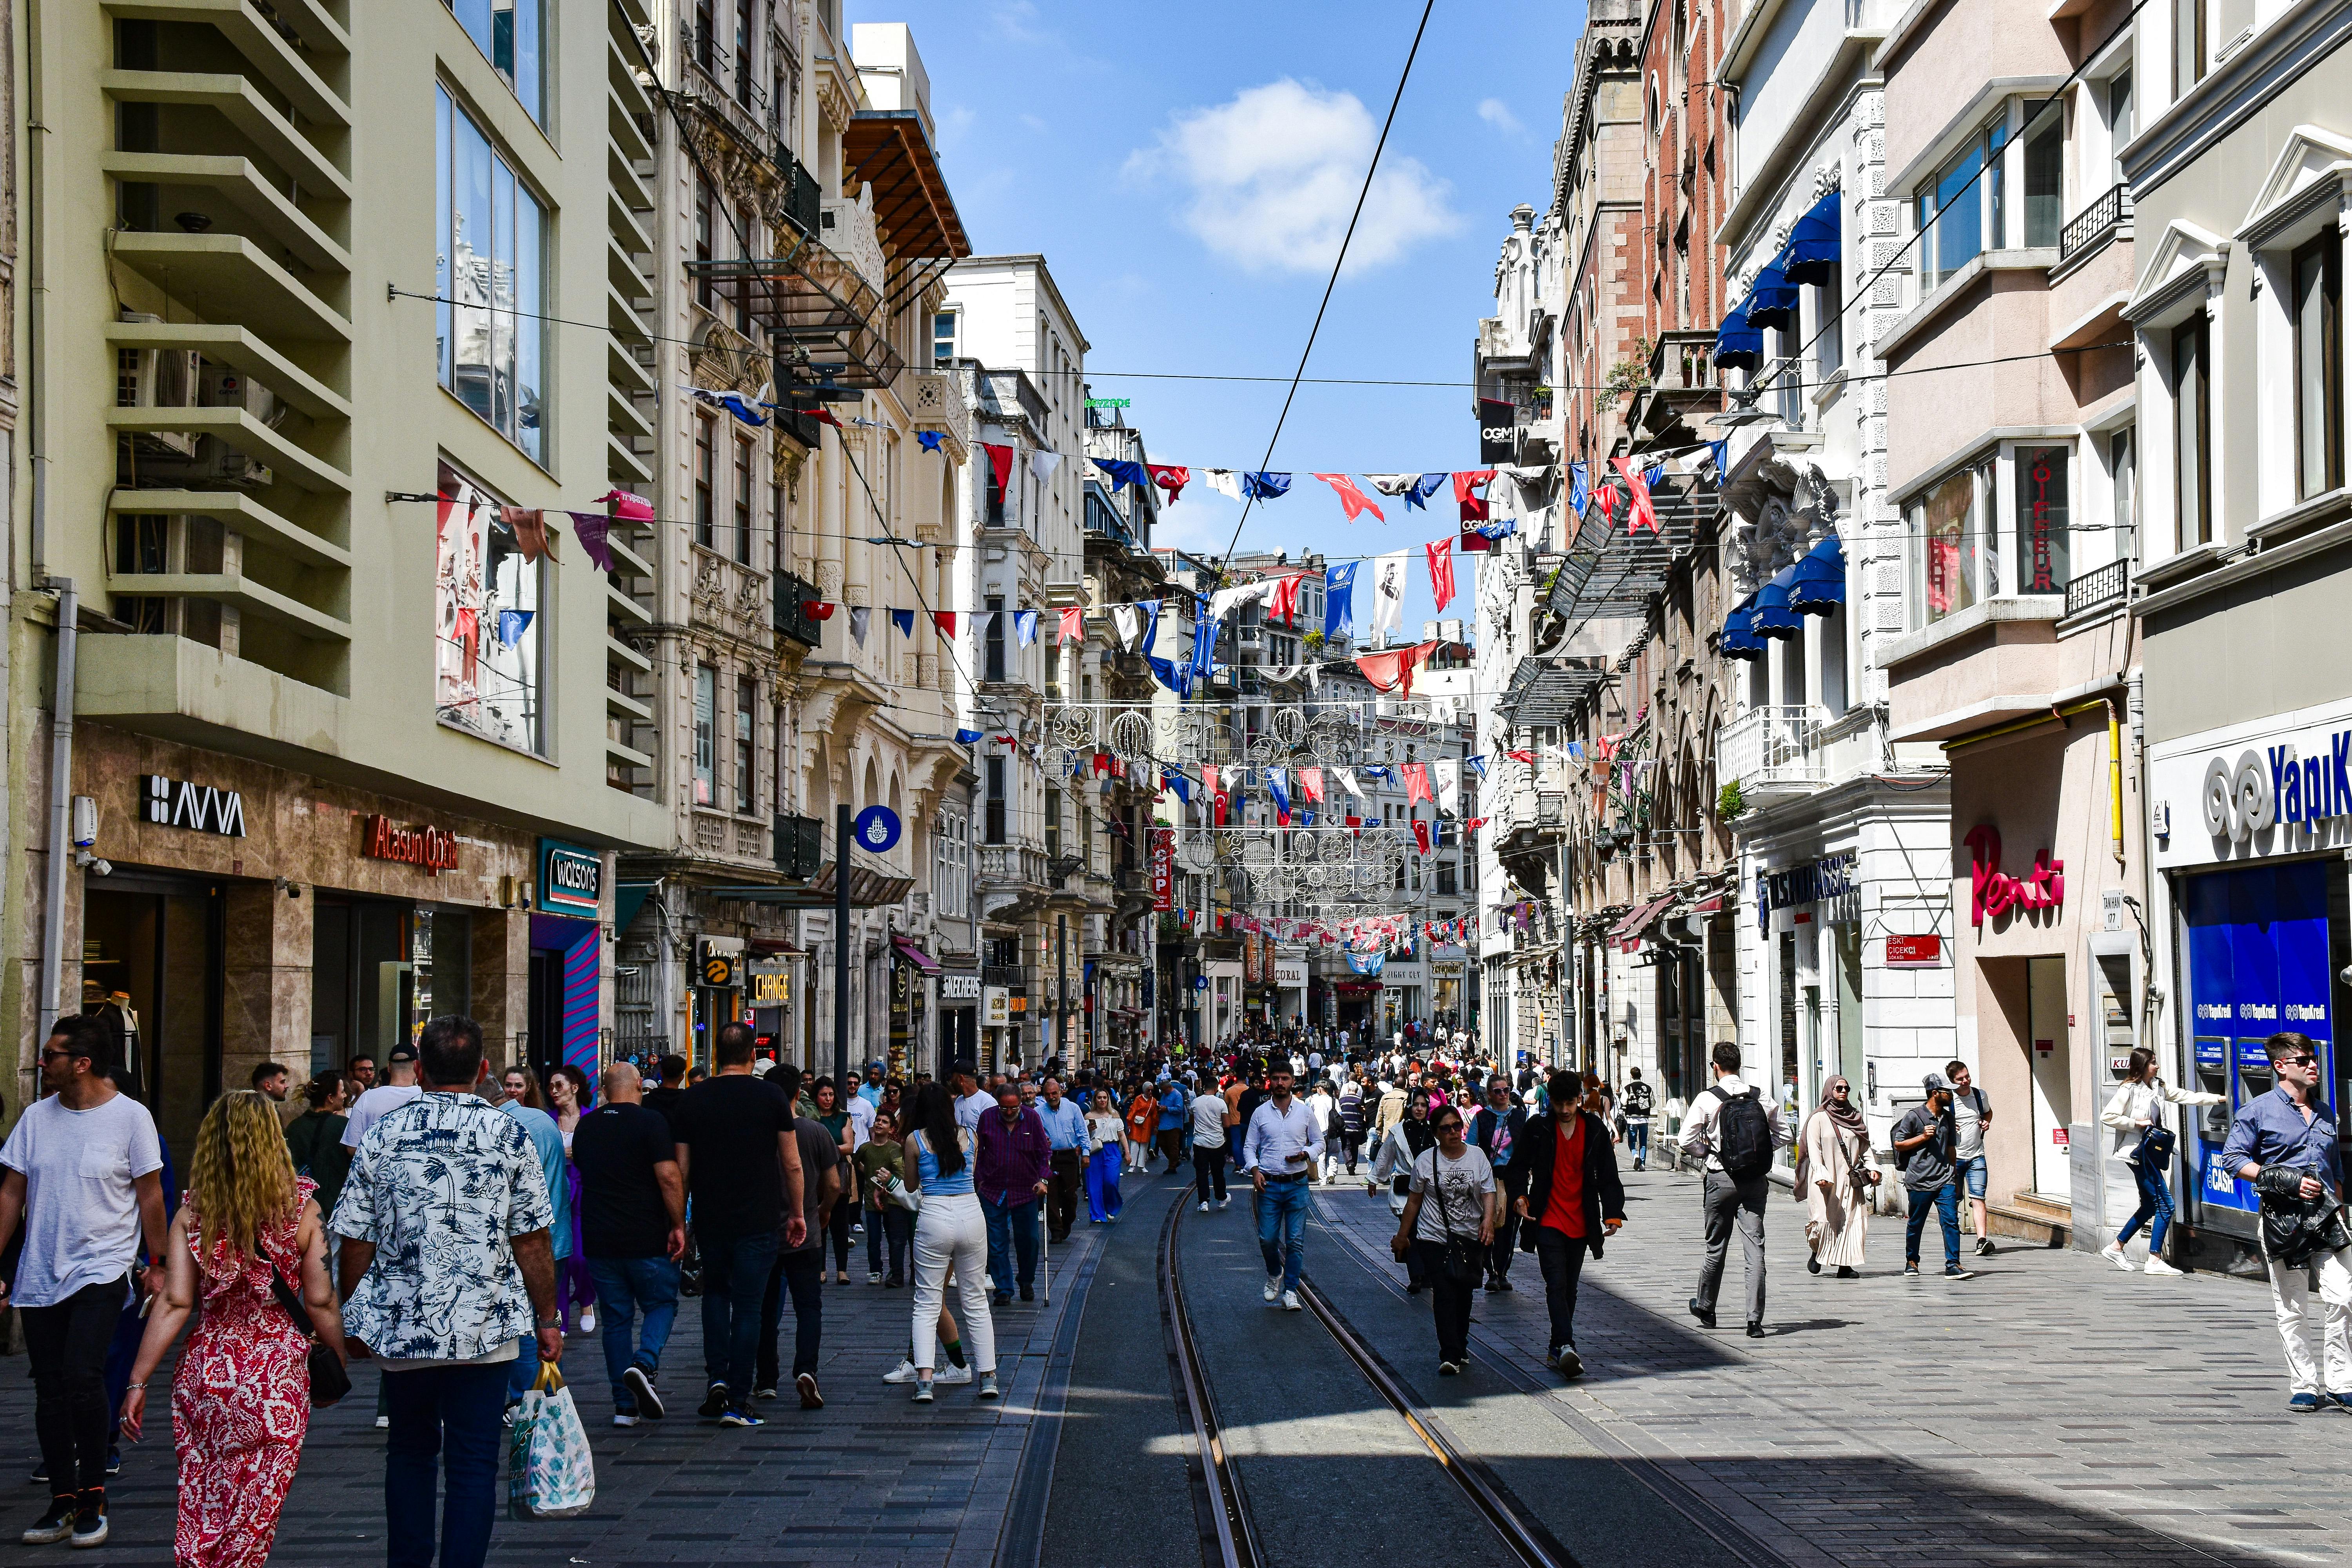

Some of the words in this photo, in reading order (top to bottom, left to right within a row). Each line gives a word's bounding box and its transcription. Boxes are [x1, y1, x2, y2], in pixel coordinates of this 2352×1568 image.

[1085, 398, 1130, 408] BEYZADE
[2033, 449, 2051, 590] COIFFEUR
[174, 781, 246, 837] AVVA
[367, 814, 423, 864] Atasun
[426, 825, 459, 877] Optik
[557, 858, 596, 891] watsons
[1964, 824, 2063, 927] Penti
[1888, 946, 1916, 955] ÇİÇEKÇİ
[1275, 969, 1301, 980] CORAL
[756, 975, 789, 1000] CHANGE
[942, 975, 980, 998] SKECHERS
[2208, 1004, 2231, 1020] YapıKredi
[2252, 1004, 2277, 1020] YapıKredi
[2298, 1004, 2325, 1022] YapıKredi
[2211, 1153, 2223, 1167] INST
[2212, 1167, 2234, 1194] CASH
